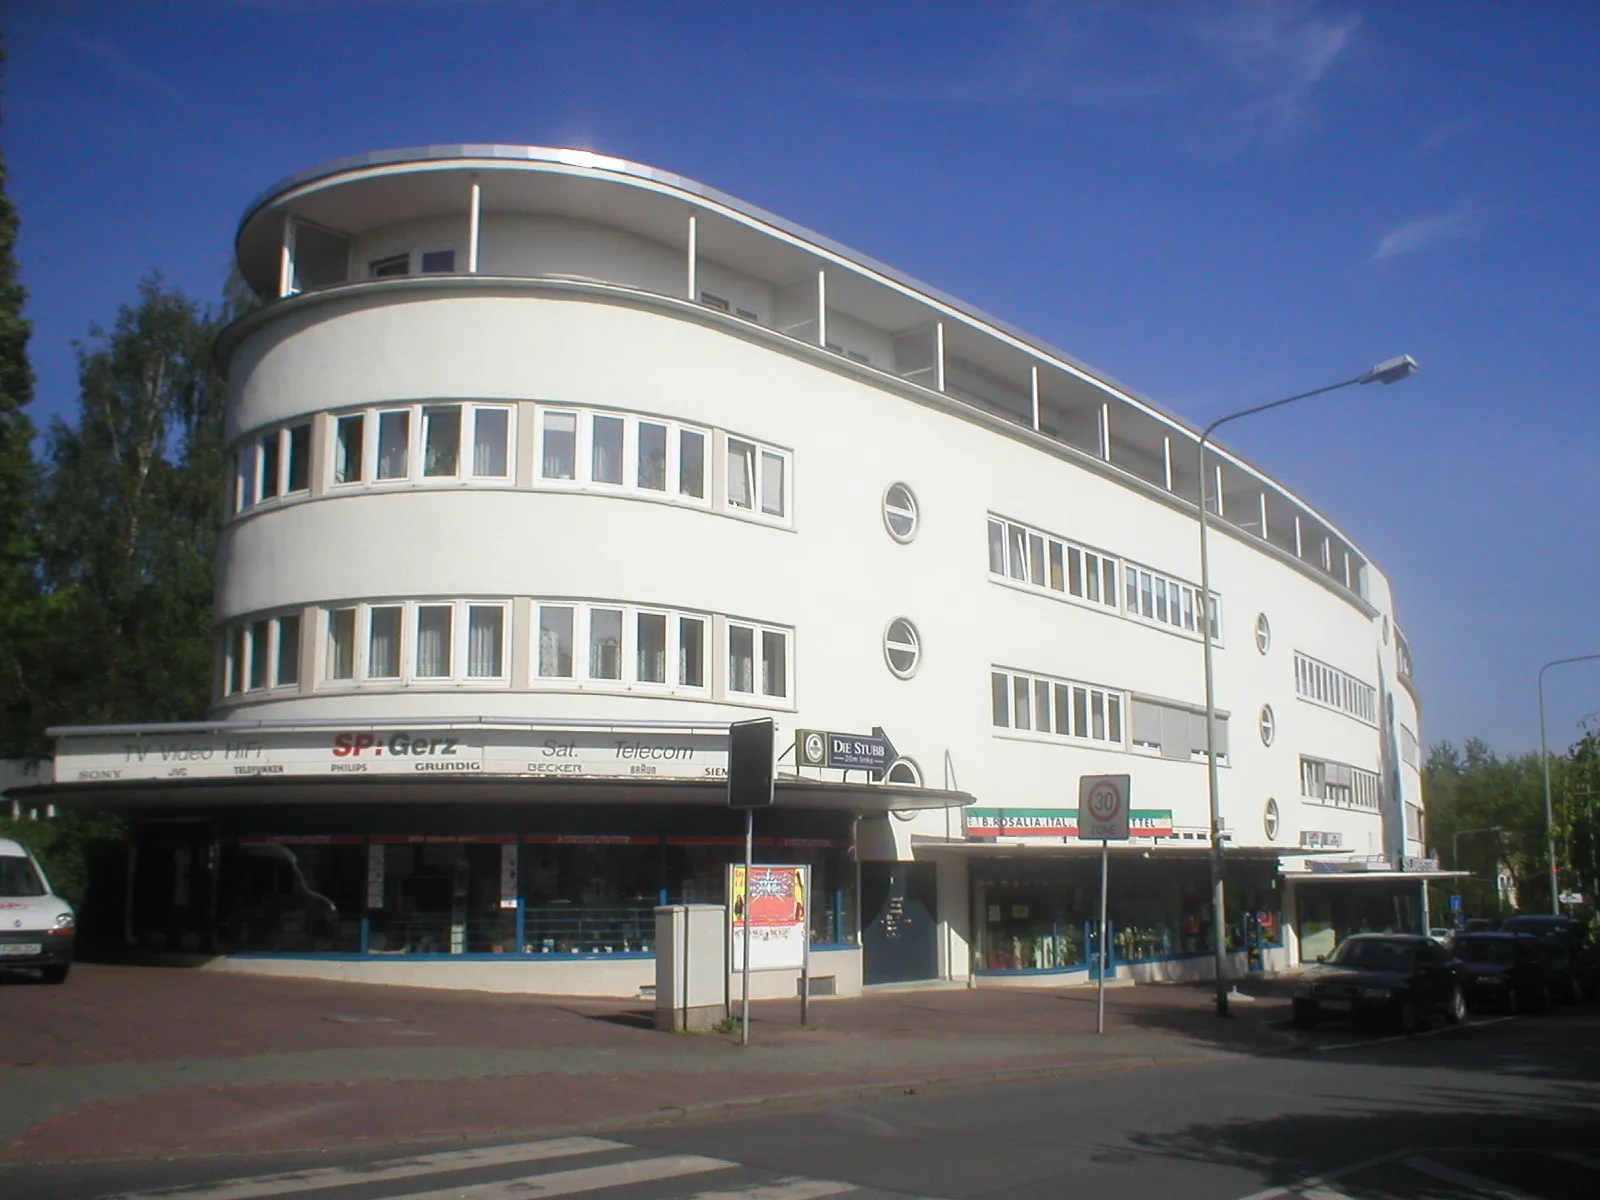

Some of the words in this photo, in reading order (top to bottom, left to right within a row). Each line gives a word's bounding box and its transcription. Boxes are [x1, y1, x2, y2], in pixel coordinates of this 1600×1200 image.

[123, 744, 151, 762] TV
[161, 743, 214, 761] Video
[542, 739, 579, 757] Sat.
[613, 740, 694, 760] Telecom
[854, 740, 885, 756] STUBB
[78, 769, 123, 779] SONY
[168, 768, 187, 776] JVC
[330, 763, 368, 772] PHILIPS
[415, 762, 481, 771] GRUNDIG
[527, 763, 583, 773] BECKER
[1094, 792, 1114, 811] 30
[1091, 824, 1117, 835] ZONE
